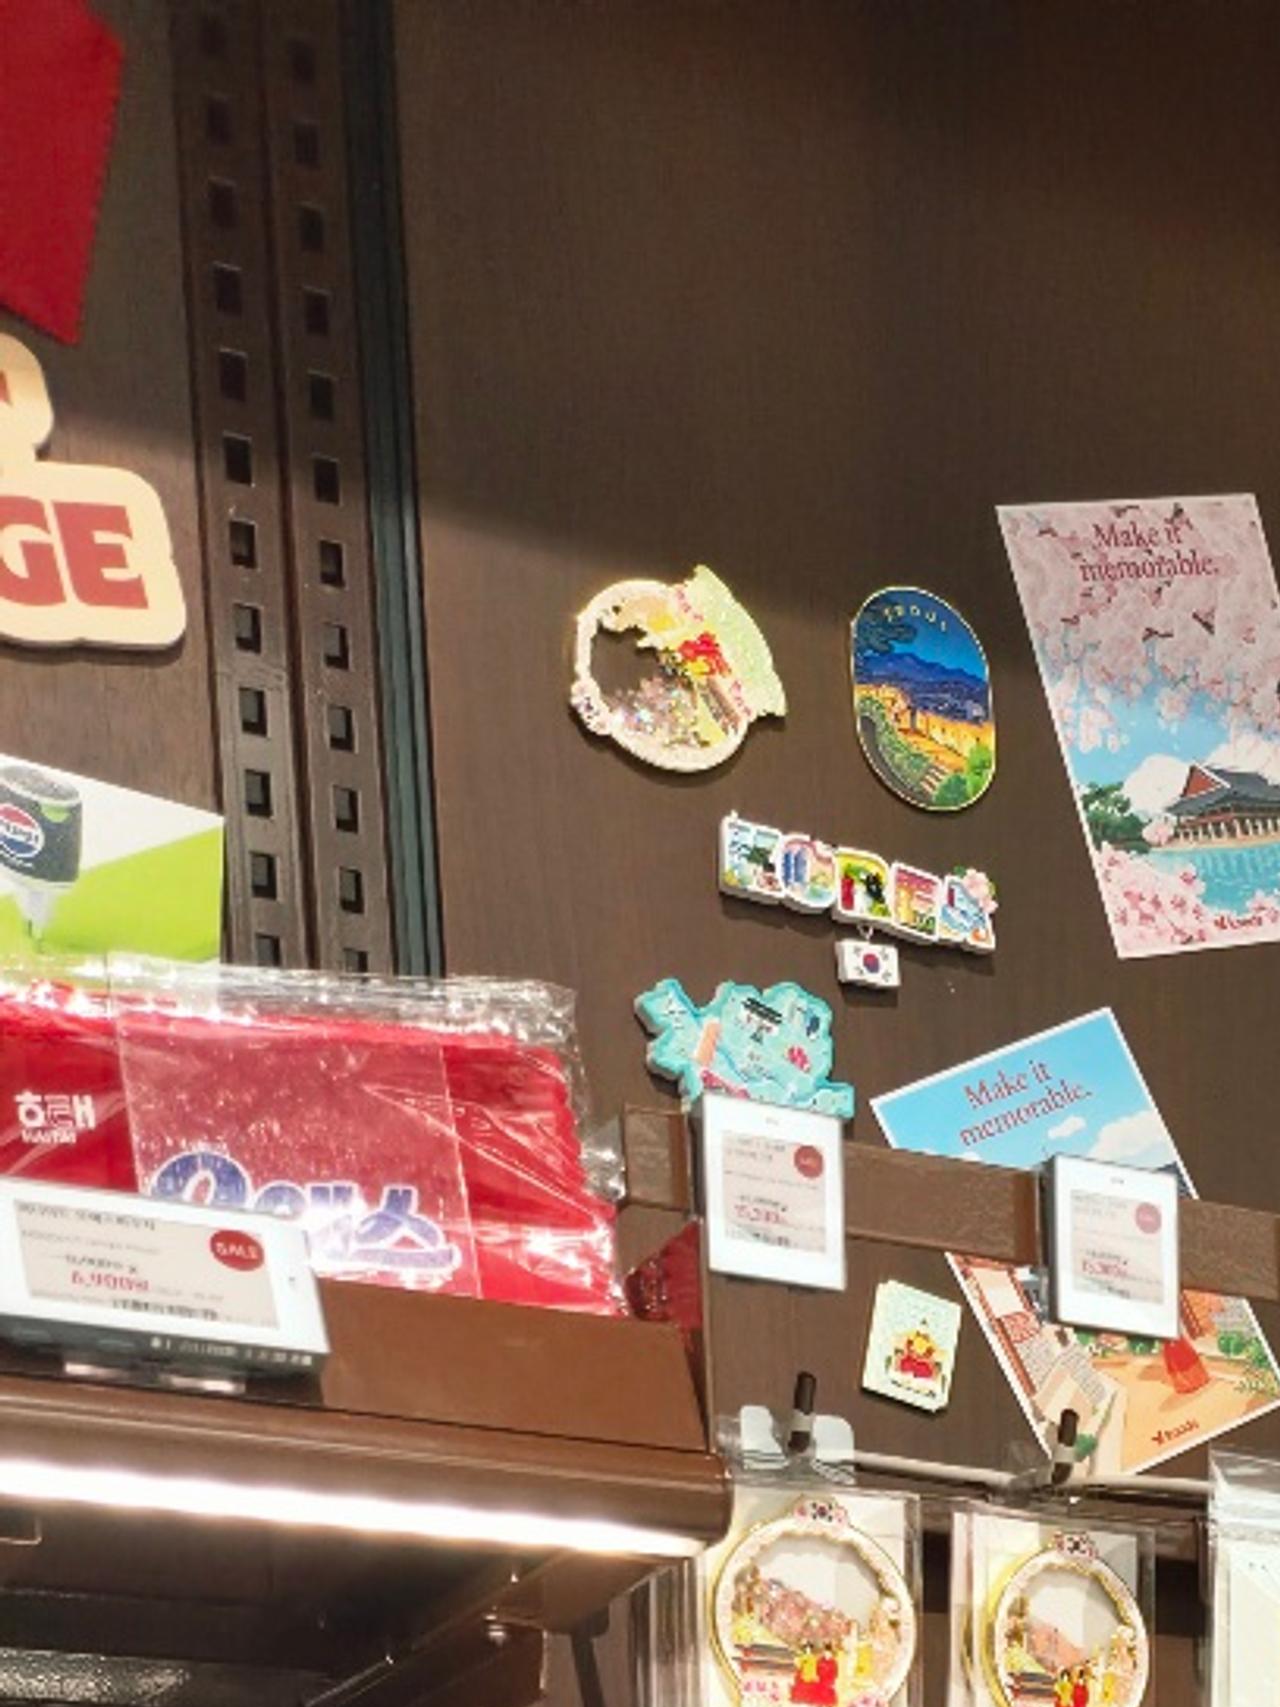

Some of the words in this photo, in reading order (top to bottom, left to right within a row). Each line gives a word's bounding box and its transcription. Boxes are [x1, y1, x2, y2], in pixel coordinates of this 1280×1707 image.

[1094, 521, 1160, 548] Make
[1165, 523, 1182, 545] it
[1080, 550, 1220, 582] memorable.
[964, 1070, 1030, 1109] Make
[1032, 1058, 1053, 1085] it
[960, 1076, 1094, 1147] memorable.
